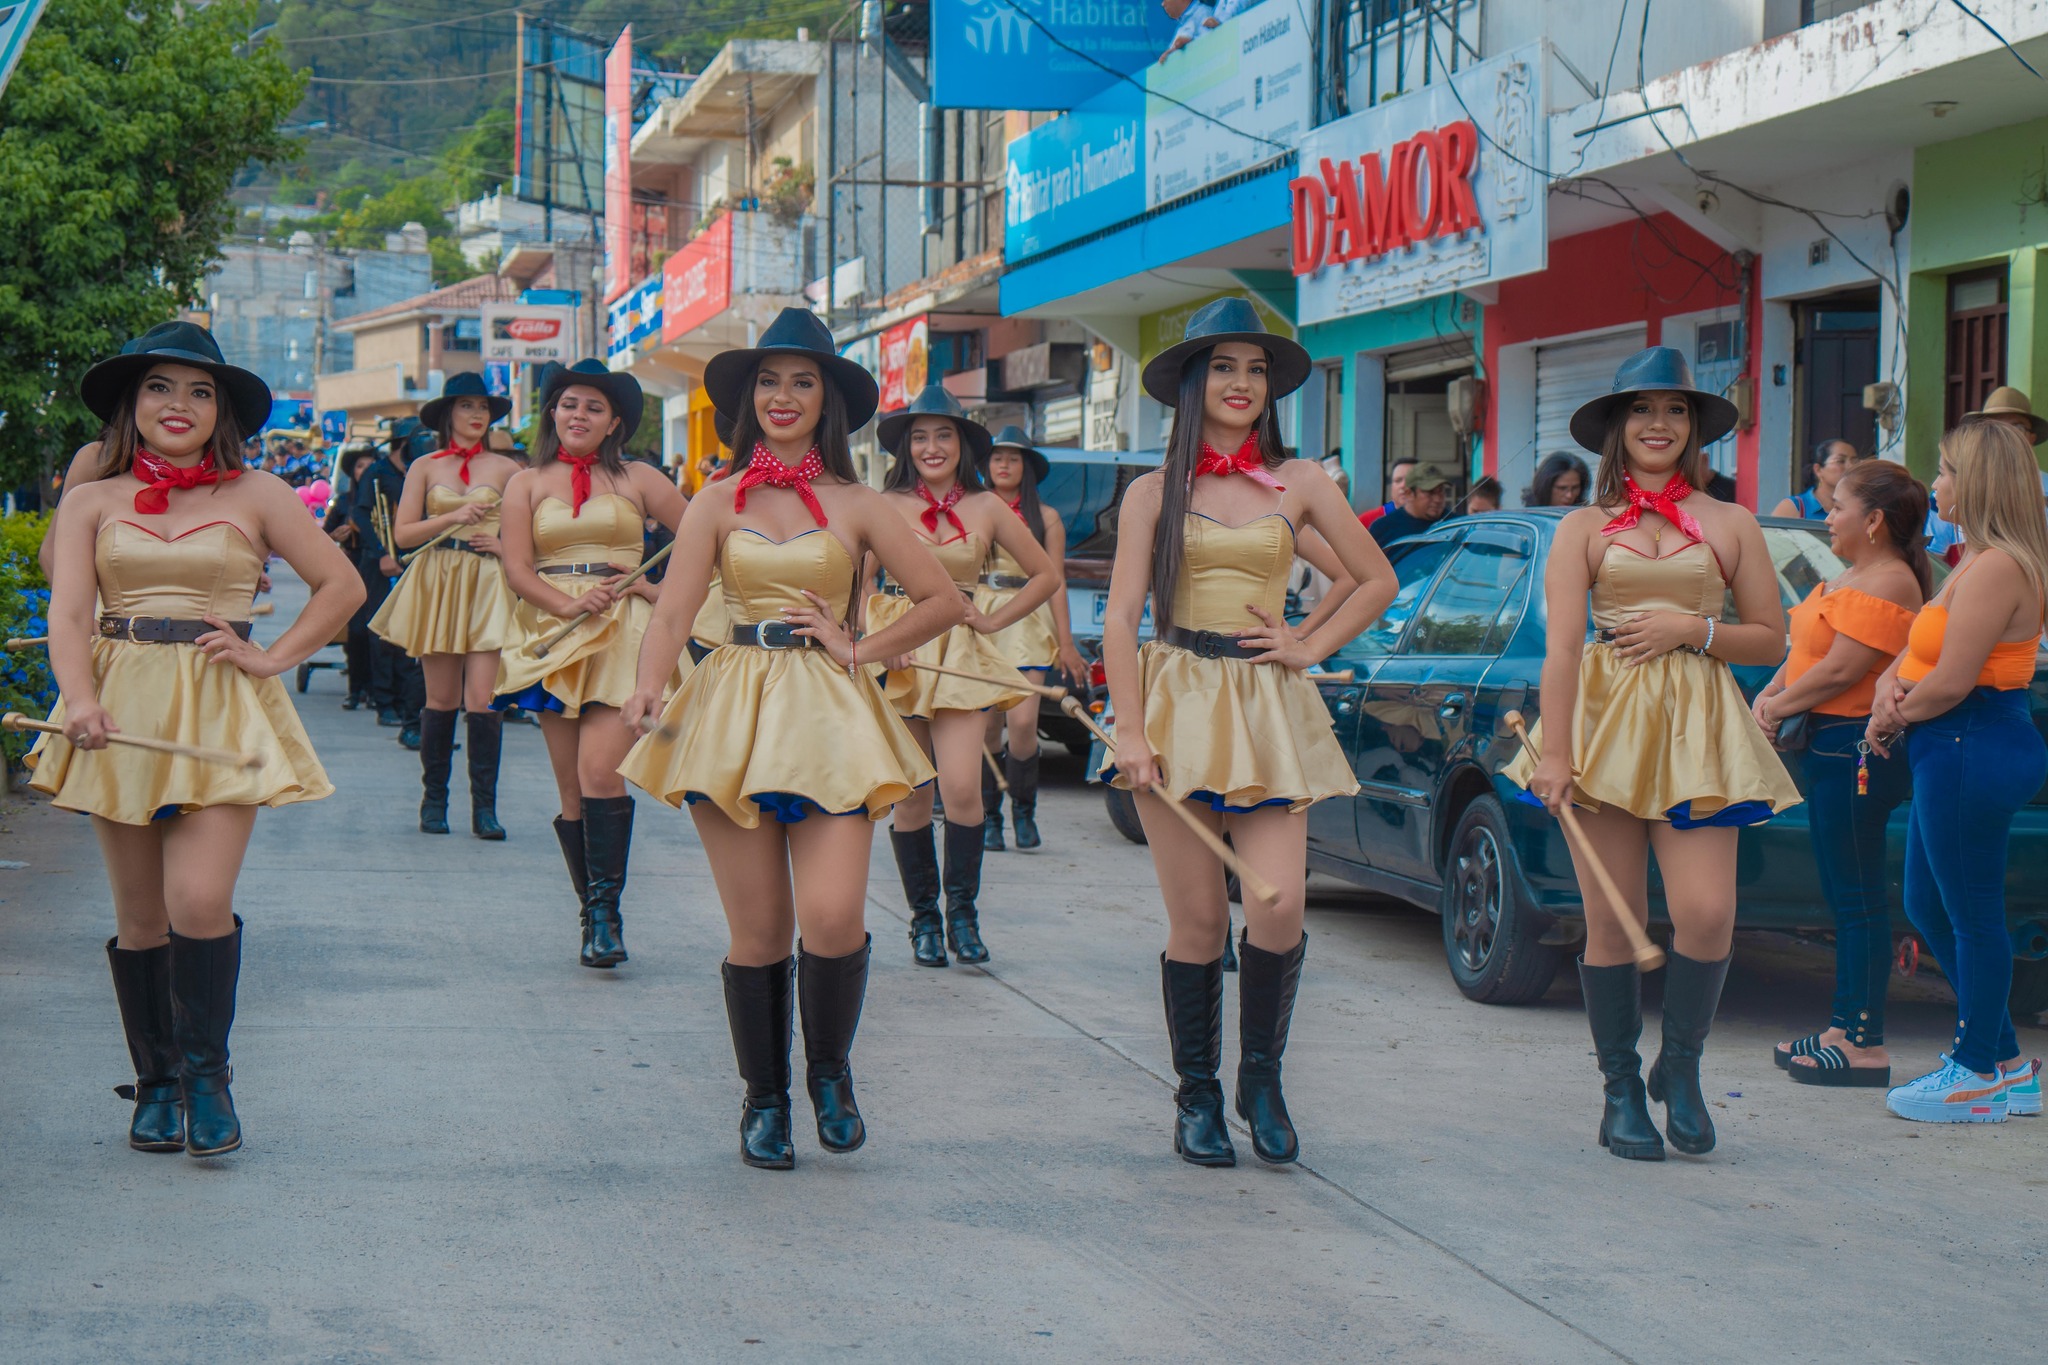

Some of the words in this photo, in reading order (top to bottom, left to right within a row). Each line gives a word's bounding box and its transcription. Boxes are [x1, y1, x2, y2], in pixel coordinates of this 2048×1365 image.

[1052, 166, 1071, 220] para
[1082, 119, 1137, 195] Humanidad
[1289, 118, 1485, 279] D'AMOR
[510, 320, 555, 336] Gallo
